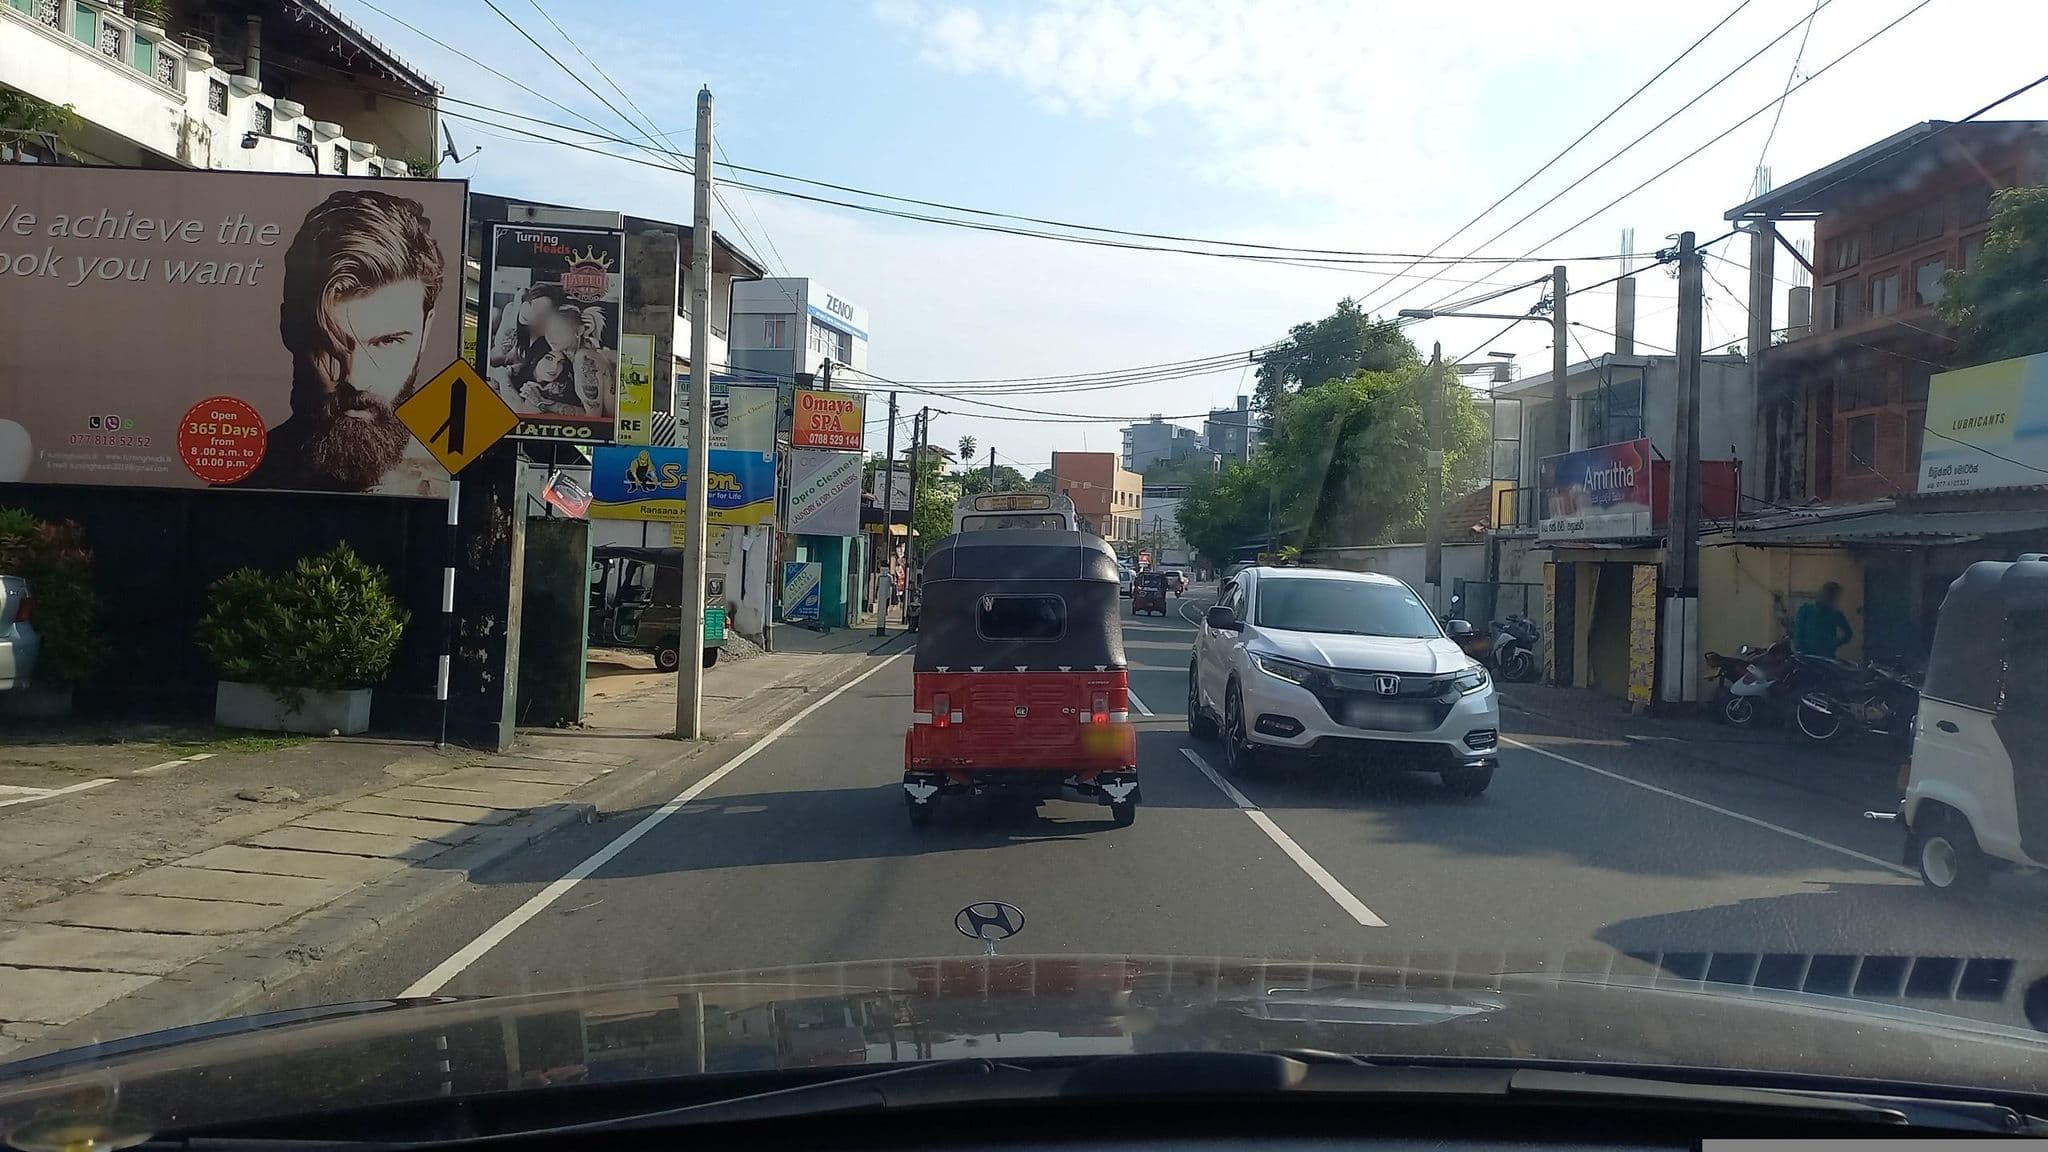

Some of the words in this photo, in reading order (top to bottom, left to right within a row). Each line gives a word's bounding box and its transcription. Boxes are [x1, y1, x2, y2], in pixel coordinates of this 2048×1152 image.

[48, 208, 205, 242] achieve
[217, 212, 281, 246] the
[534, 243, 571, 254] Heads
[67, 256, 151, 287] you
[164, 257, 264, 286] want
[802, 394, 854, 415] Omaya
[211, 411, 237, 421] Open
[810, 414, 842, 431] SPA
[1952, 412, 2006, 431] LUBRICANTS
[189, 423, 217, 435] 365
[222, 424, 258, 439] Days
[516, 422, 592, 438] TATTOO
[70, 435, 91, 444] 077
[95, 435, 116, 446] 818
[120, 437, 133, 447] 52
[137, 437, 151, 447] 52
[211, 437, 235, 446] from
[829, 434, 844, 445] 529
[846, 435, 859, 447] 144
[218, 449, 241, 457] a.m.
[243, 449, 254, 457] to
[195, 458, 224, 467] 10.00
[226, 460, 248, 468] p.m.
[792, 487, 816, 505] Opro
[816, 456, 860, 488] Cleaners
[1584, 460, 1635, 491] Amritha
[728, 492, 742, 500] Life
[640, 505, 679, 515] Ransana
